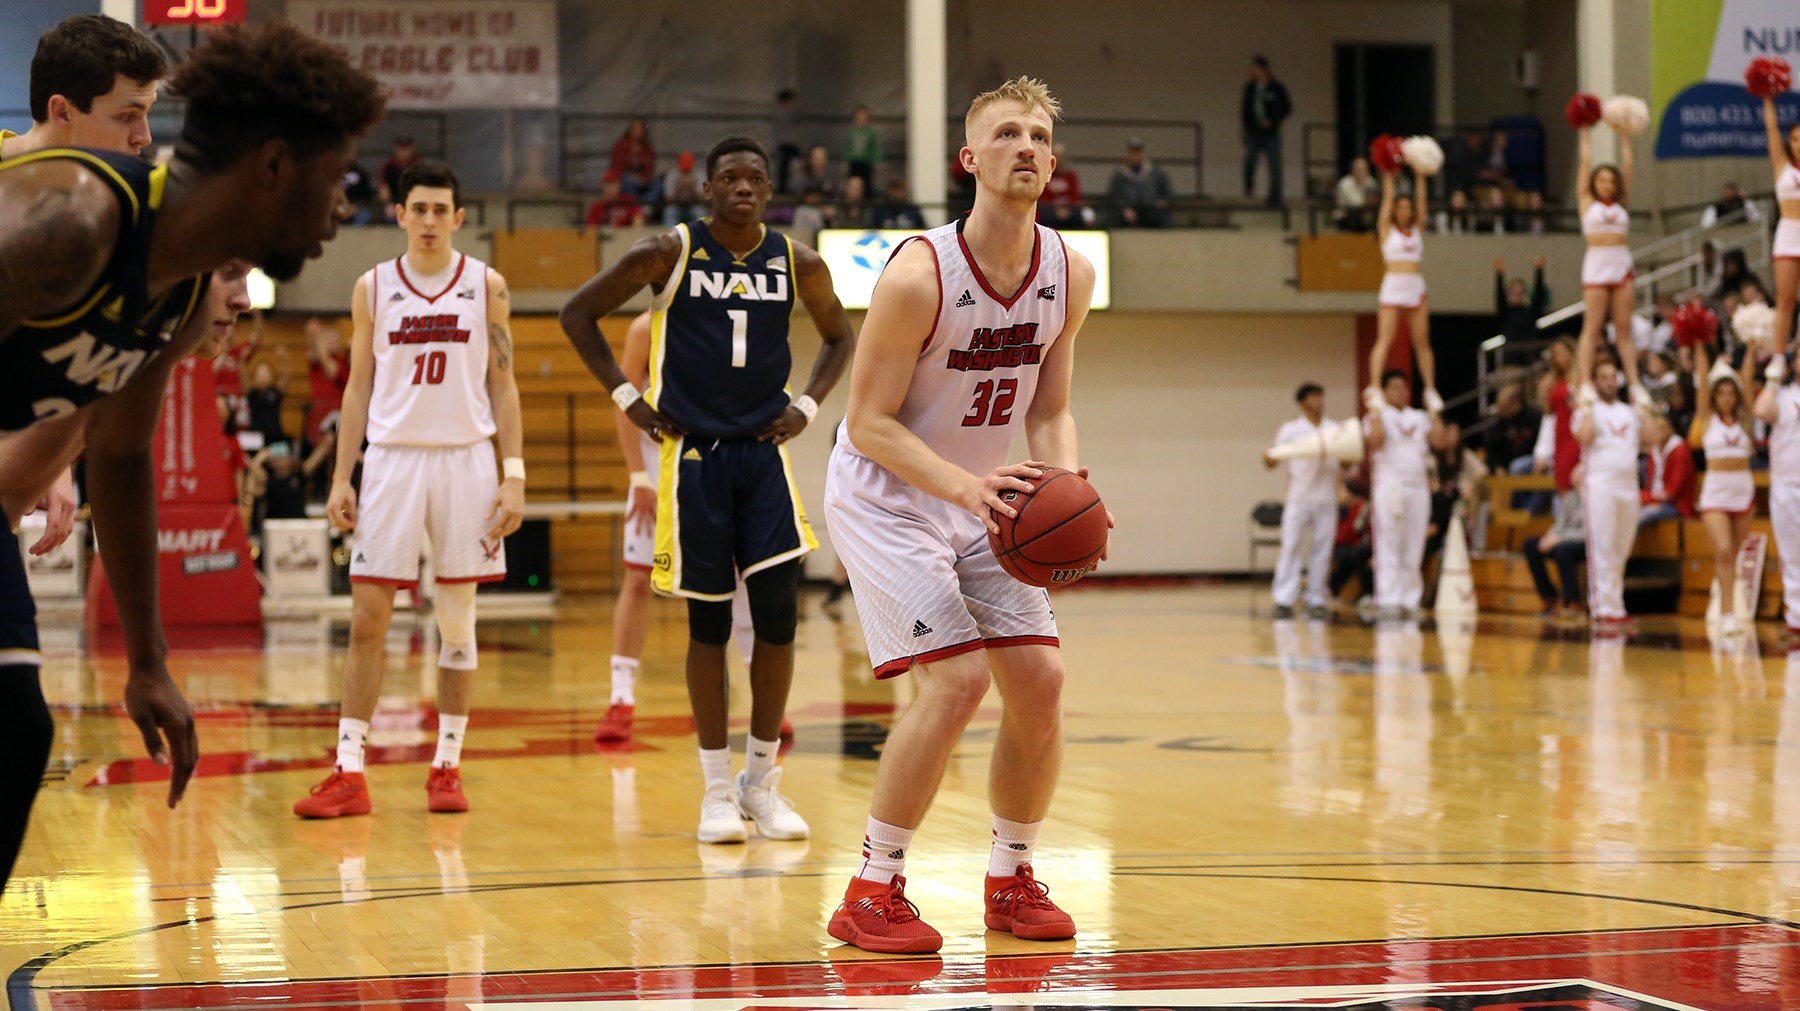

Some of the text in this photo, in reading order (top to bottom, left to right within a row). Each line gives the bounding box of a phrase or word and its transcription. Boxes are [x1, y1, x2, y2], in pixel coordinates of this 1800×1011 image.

[1744, 26, 1800, 53] NU
[465, 44, 541, 74] CLUB
[689, 269, 788, 301] NAU
[726, 309, 748, 368] 1
[968, 322, 1040, 350] EASTERN
[40, 329, 160, 393] NA
[411, 351, 447, 386] 10
[960, 377, 1019, 427] 32
